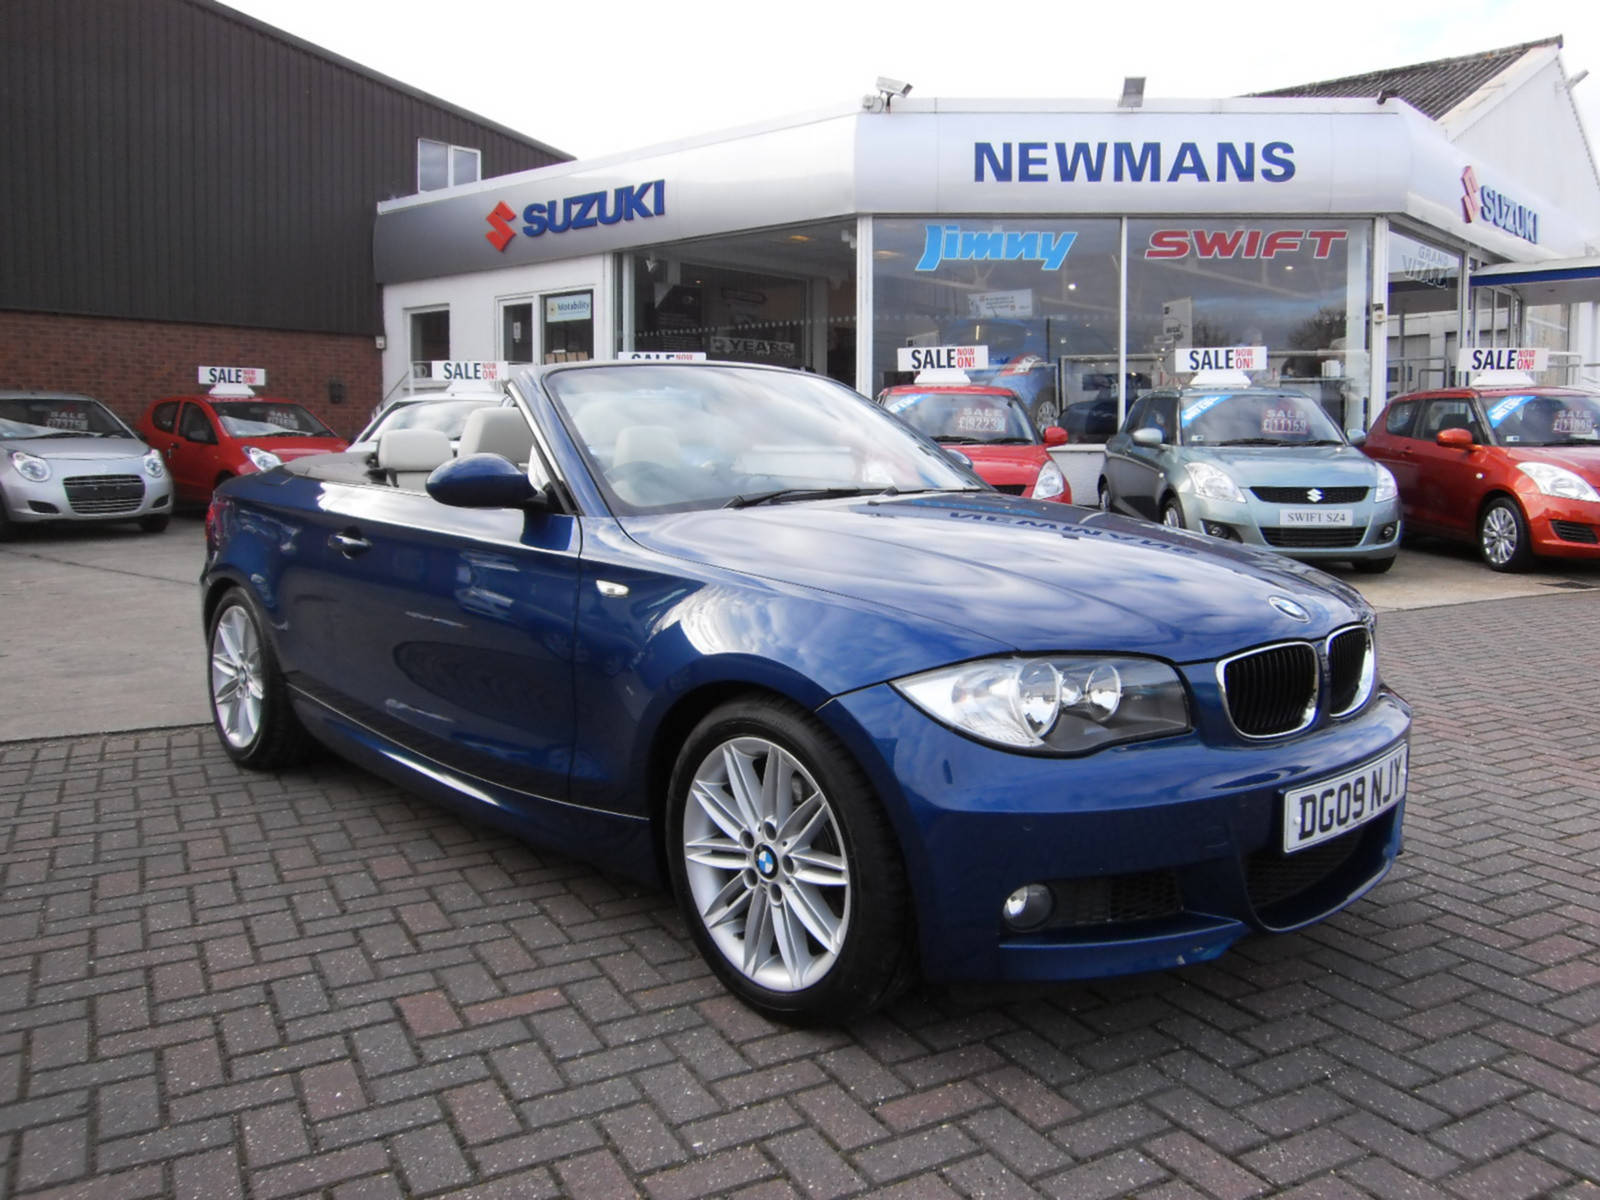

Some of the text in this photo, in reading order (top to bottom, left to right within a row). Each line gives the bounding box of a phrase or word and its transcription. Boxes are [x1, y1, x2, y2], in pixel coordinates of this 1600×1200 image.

[974, 141, 1296, 183] NEWMANS
[522, 179, 665, 237] SUZUKI
[1480, 185, 1540, 244] SUZUKI
[915, 225, 1078, 271] Jimny
[1144, 230, 1348, 260] SWIFT
[557, 301, 589, 311] Motability
[728, 340, 794, 355] YEARS
[957, 348, 975, 356] NOW
[1235, 349, 1253, 357] NOW
[911, 349, 956, 369] SALE
[957, 357, 975, 368] ON!
[1189, 350, 1234, 370] SALE
[1235, 358, 1254, 369] ON!
[1472, 350, 1517, 370] SALE
[1516, 359, 1534, 370] ON!
[209, 367, 242, 384] SALE
[443, 362, 481, 379] SALE
[1288, 512, 1346, 522] SWIFT SZ4
[1298, 754, 1403, 841] DG09 NJY
